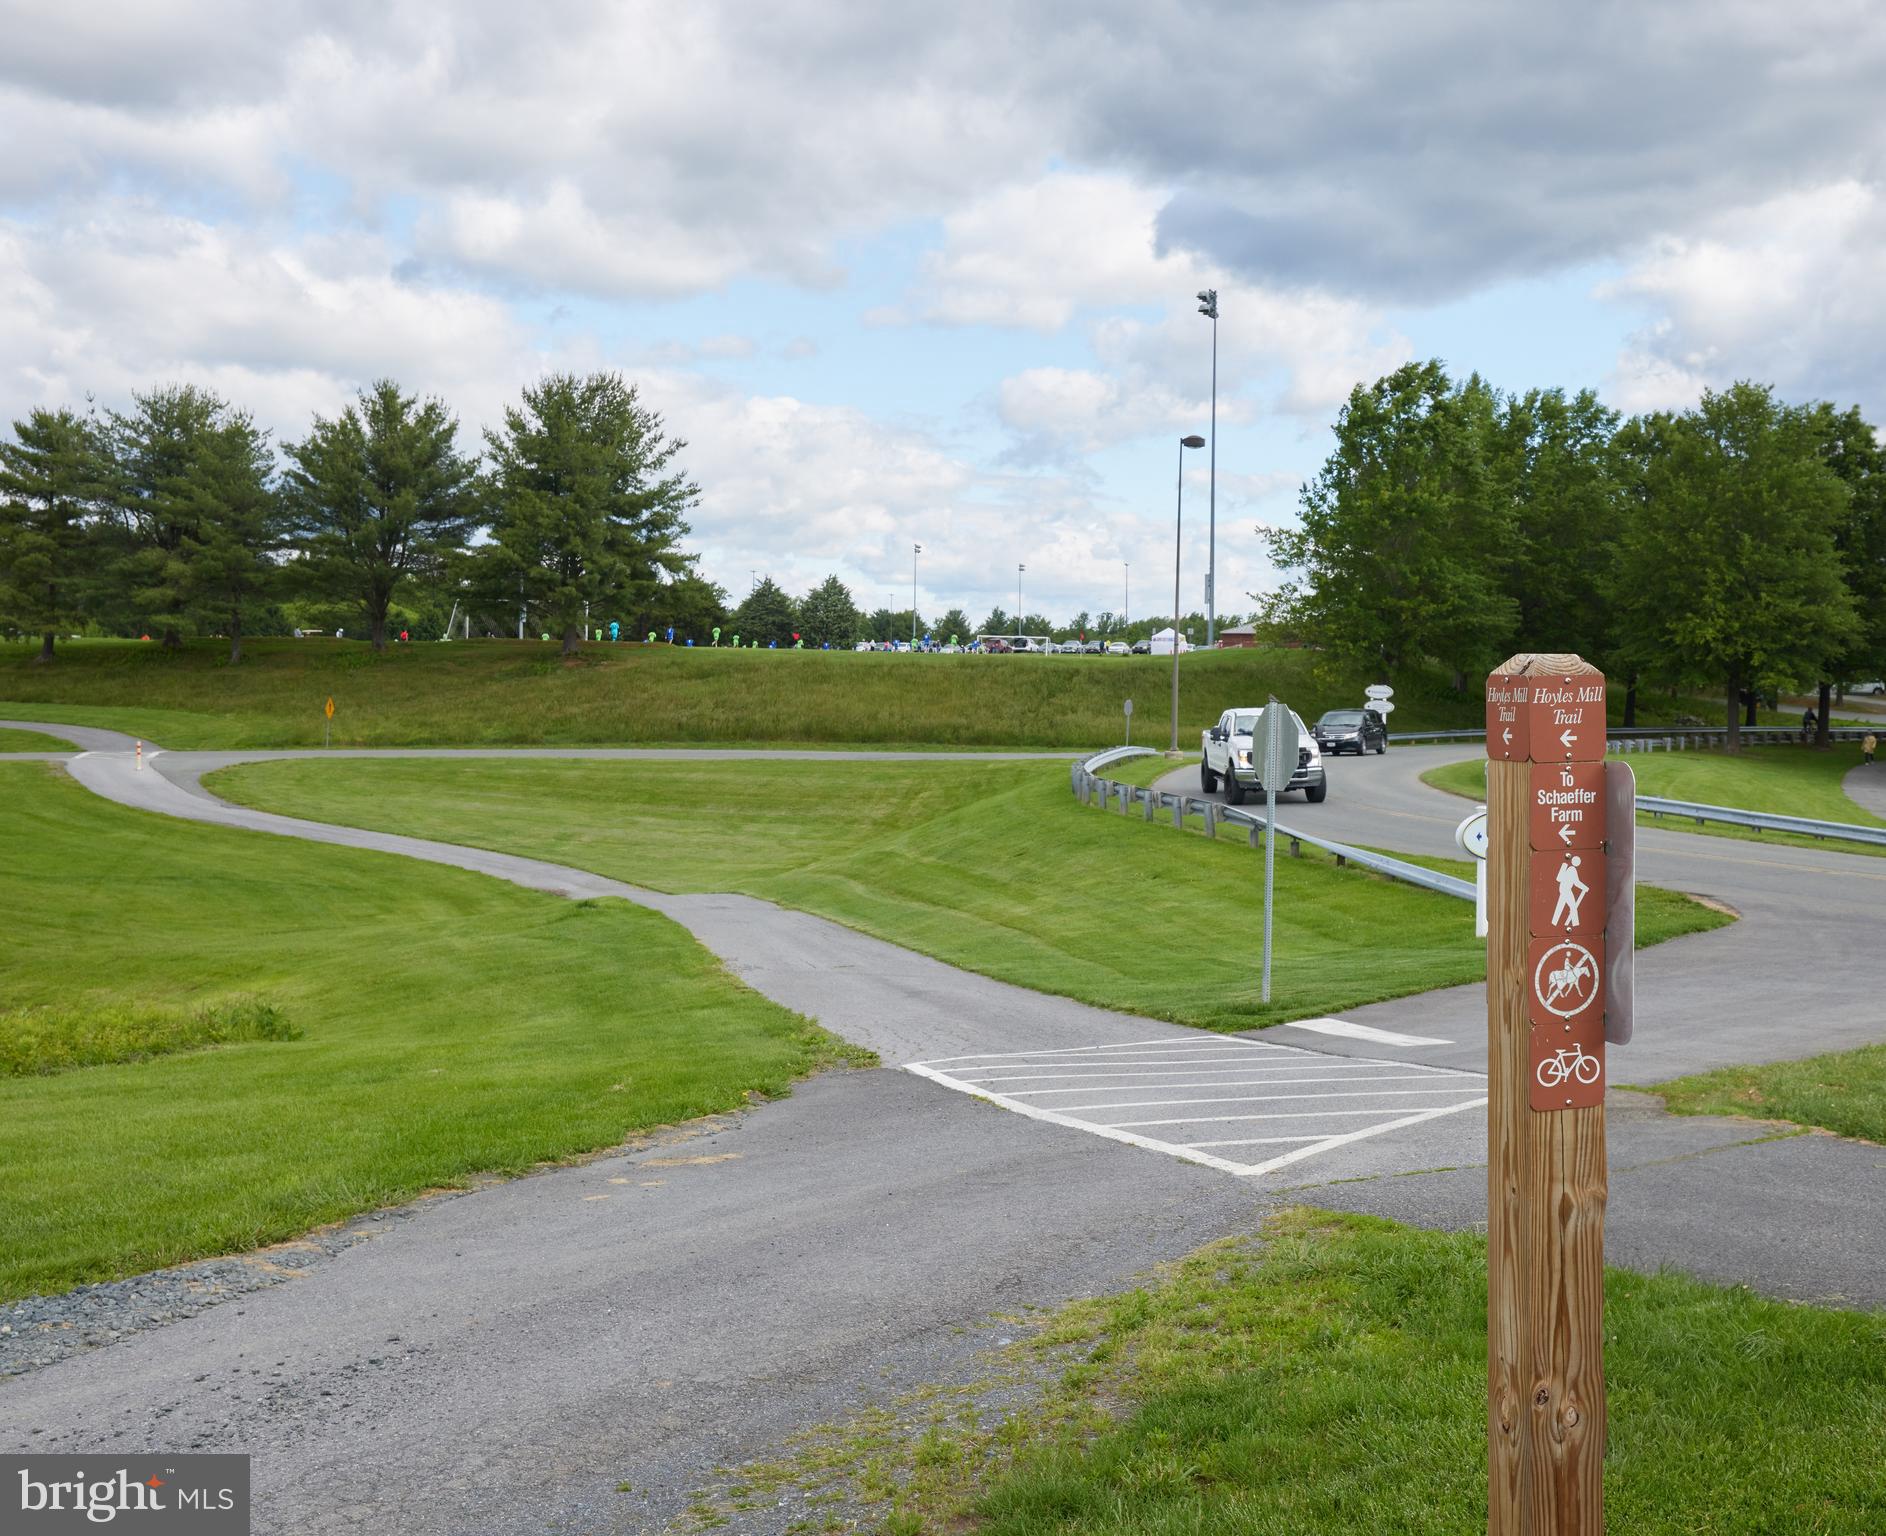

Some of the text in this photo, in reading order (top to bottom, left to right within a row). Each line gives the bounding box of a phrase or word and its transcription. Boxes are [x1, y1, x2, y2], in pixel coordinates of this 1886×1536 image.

[1488, 687, 1528, 706] Hoyles Mill
[1532, 686, 1603, 707] Hoyles Mill
[1499, 706, 1516, 722] Trail
[1553, 708, 1583, 725] Trail
[1560, 771, 1574, 787] To
[1537, 788, 1597, 805] Schaeffer
[1551, 807, 1583, 823] Farm
